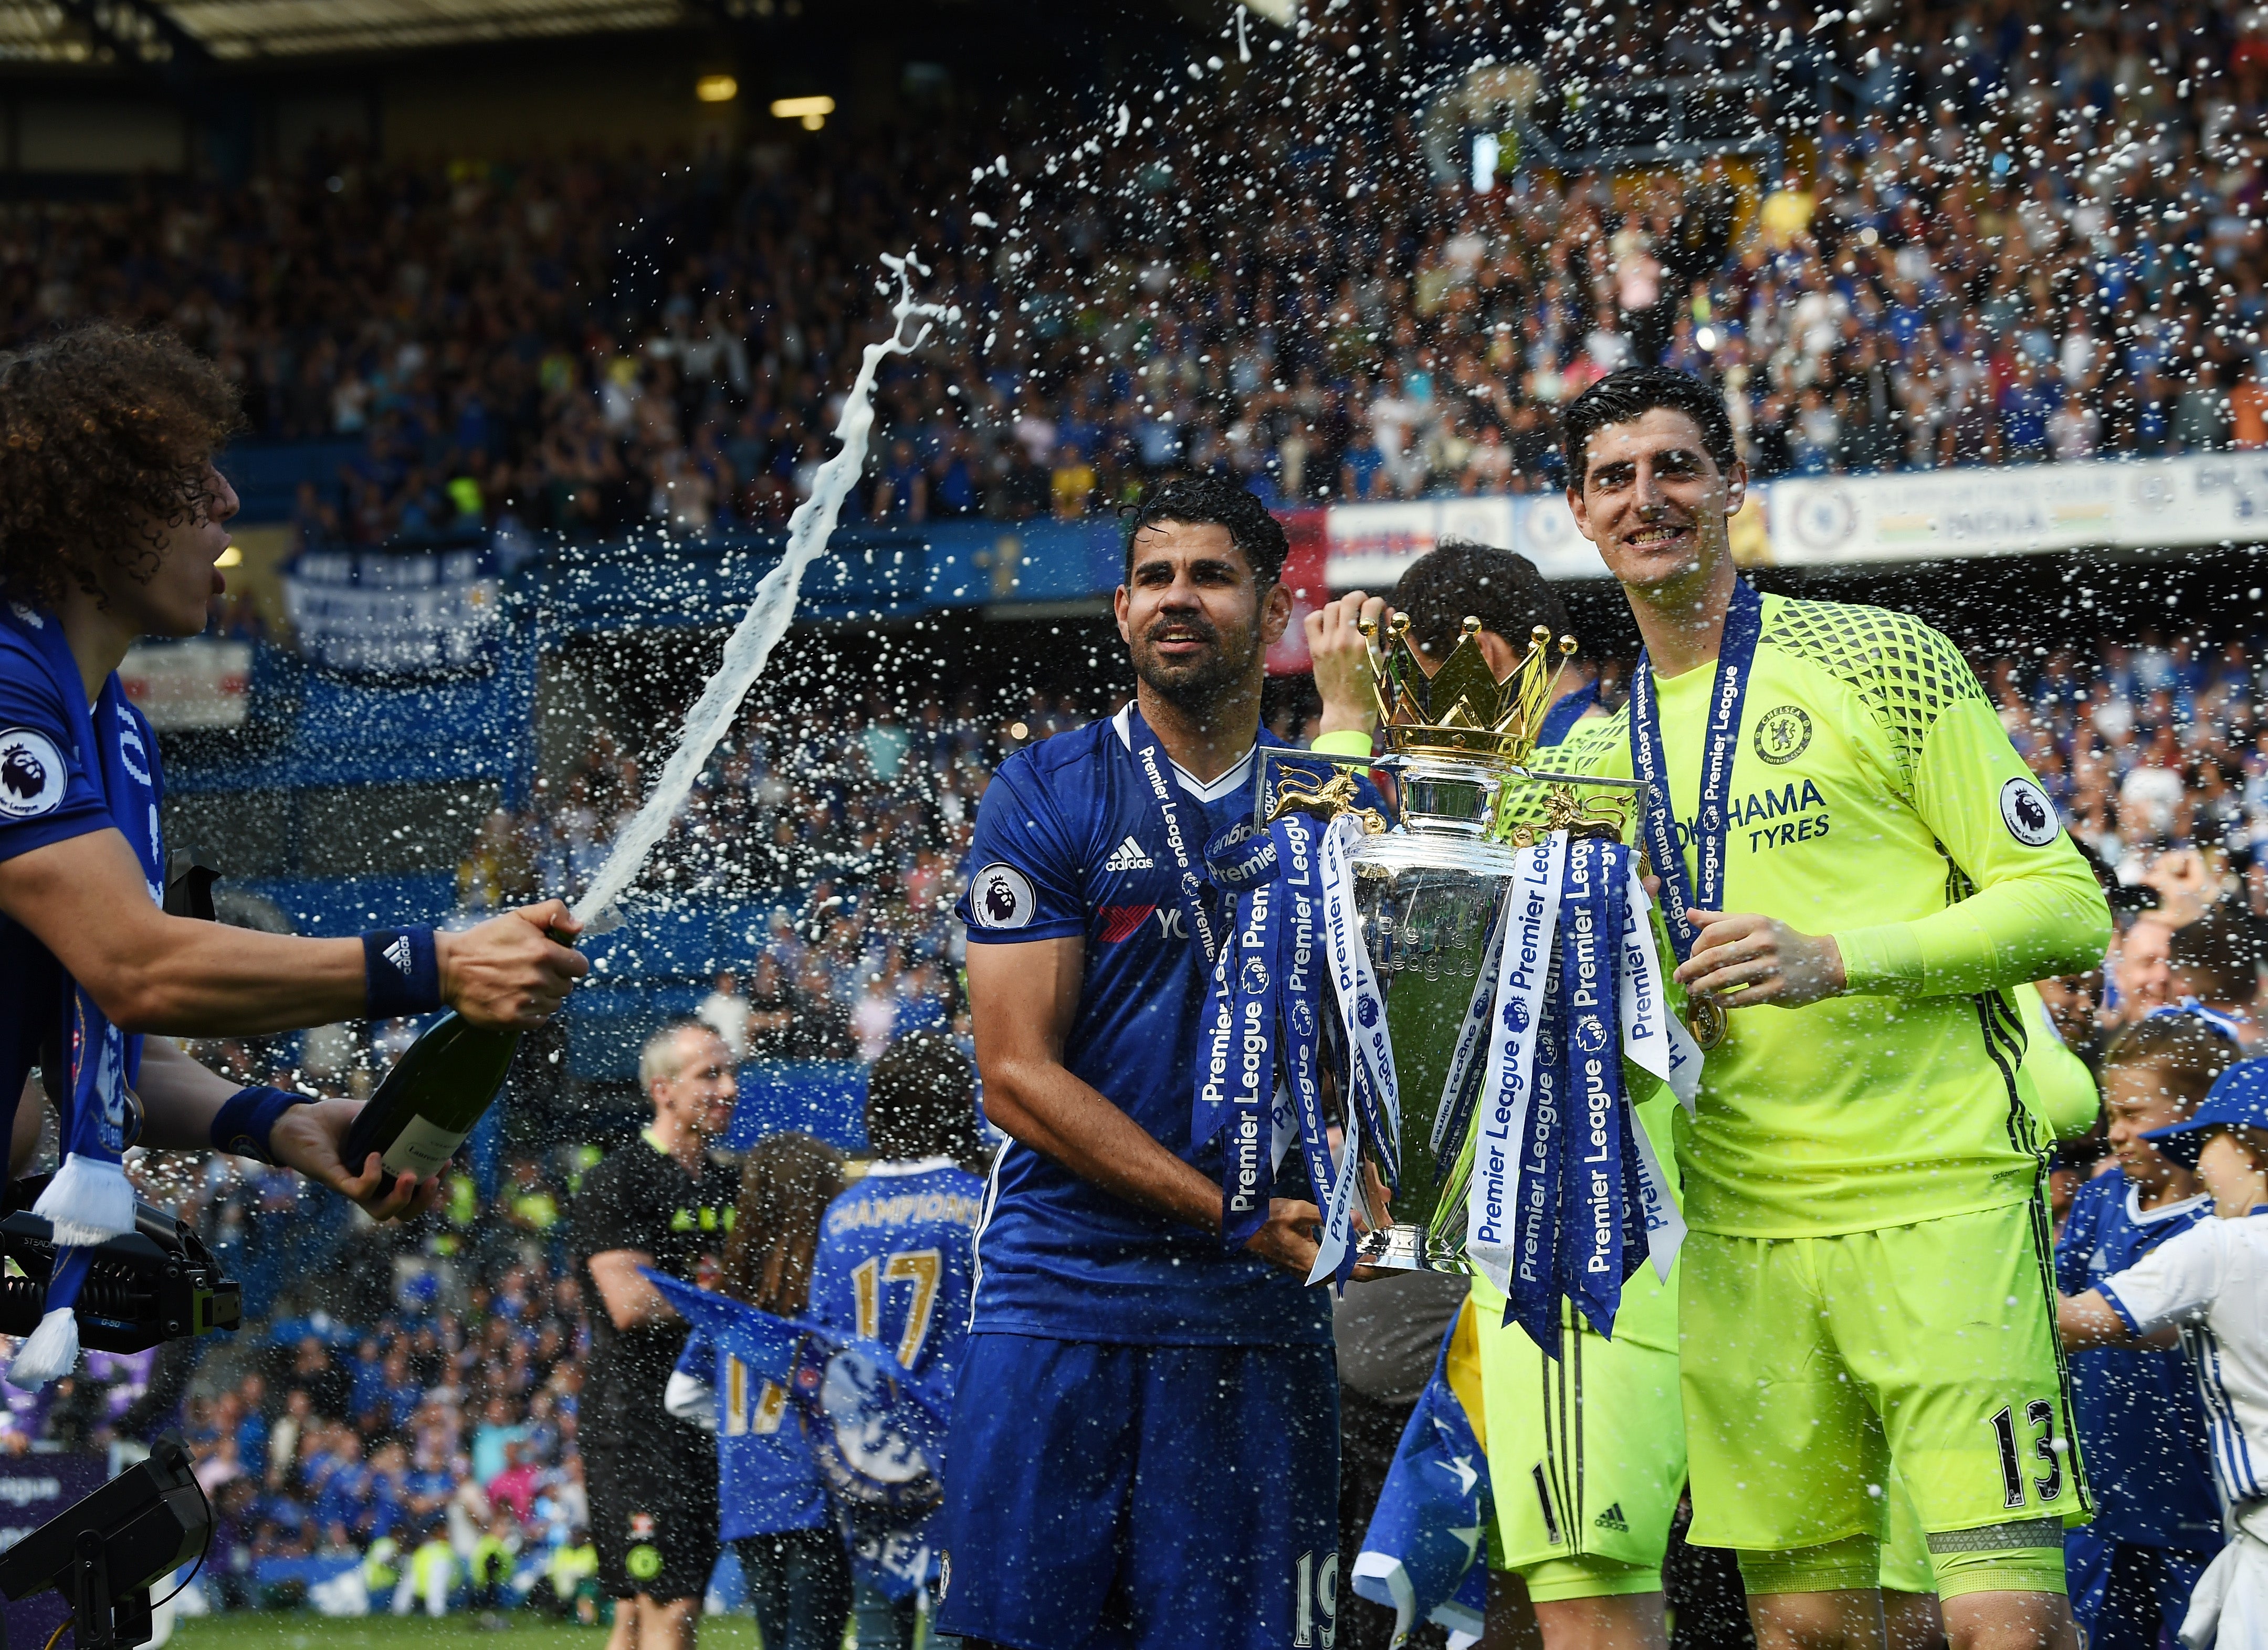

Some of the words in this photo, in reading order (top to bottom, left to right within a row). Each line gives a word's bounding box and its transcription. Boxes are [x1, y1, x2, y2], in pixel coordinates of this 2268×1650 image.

[1637, 662, 1648, 720] Premier
[1712, 665, 1738, 732] League
[1761, 707, 1801, 724] CHELSEA
[1637, 720, 1655, 781] League
[1705, 733, 1727, 800] Premier
[1138, 745, 1170, 800] Premier
[1160, 802, 1189, 868] League
[1282, 815, 1310, 886] Leagu
[1651, 808, 1675, 871] Premier
[1749, 814, 1830, 854] TYRES
[1105, 856, 1154, 872] adidas
[1206, 842, 1277, 882] Premier
[1524, 834, 1558, 886] Leag
[1665, 873, 1691, 939] League
[1701, 834, 1719, 903] League
[399, 936, 412, 975] adidas
[1242, 883, 1270, 948] Prem
[1290, 892, 1312, 992] Premier
[1326, 894, 1354, 992] Premier
[1374, 943, 1476, 982] League
[1509, 888, 1546, 992] Premier
[1568, 905, 1599, 1007] Premier
[1625, 943, 1654, 1041] Premier
[1202, 1003, 1233, 1102] Premier
[1234, 1001, 1268, 1103] League
[1299, 1044, 1319, 1144] League
[1486, 1041, 1524, 1141] League
[1526, 1073, 1557, 1175] League
[1584, 1058, 1611, 1163] League
[1231, 1110, 1259, 1212] Premier
[1311, 1151, 1332, 1205] mier
[1331, 1141, 1356, 1243] Premier
[1478, 1145, 1506, 1245] Premier
[1519, 1180, 1546, 1283] Premier
[1588, 1169, 1610, 1273] Premier
[101, 1318, 121, 1328] G-50
[850, 1246, 942, 1370] 17
[1989, 1399, 2062, 1508] 13
[1293, 1550, 1339, 1649] 19
